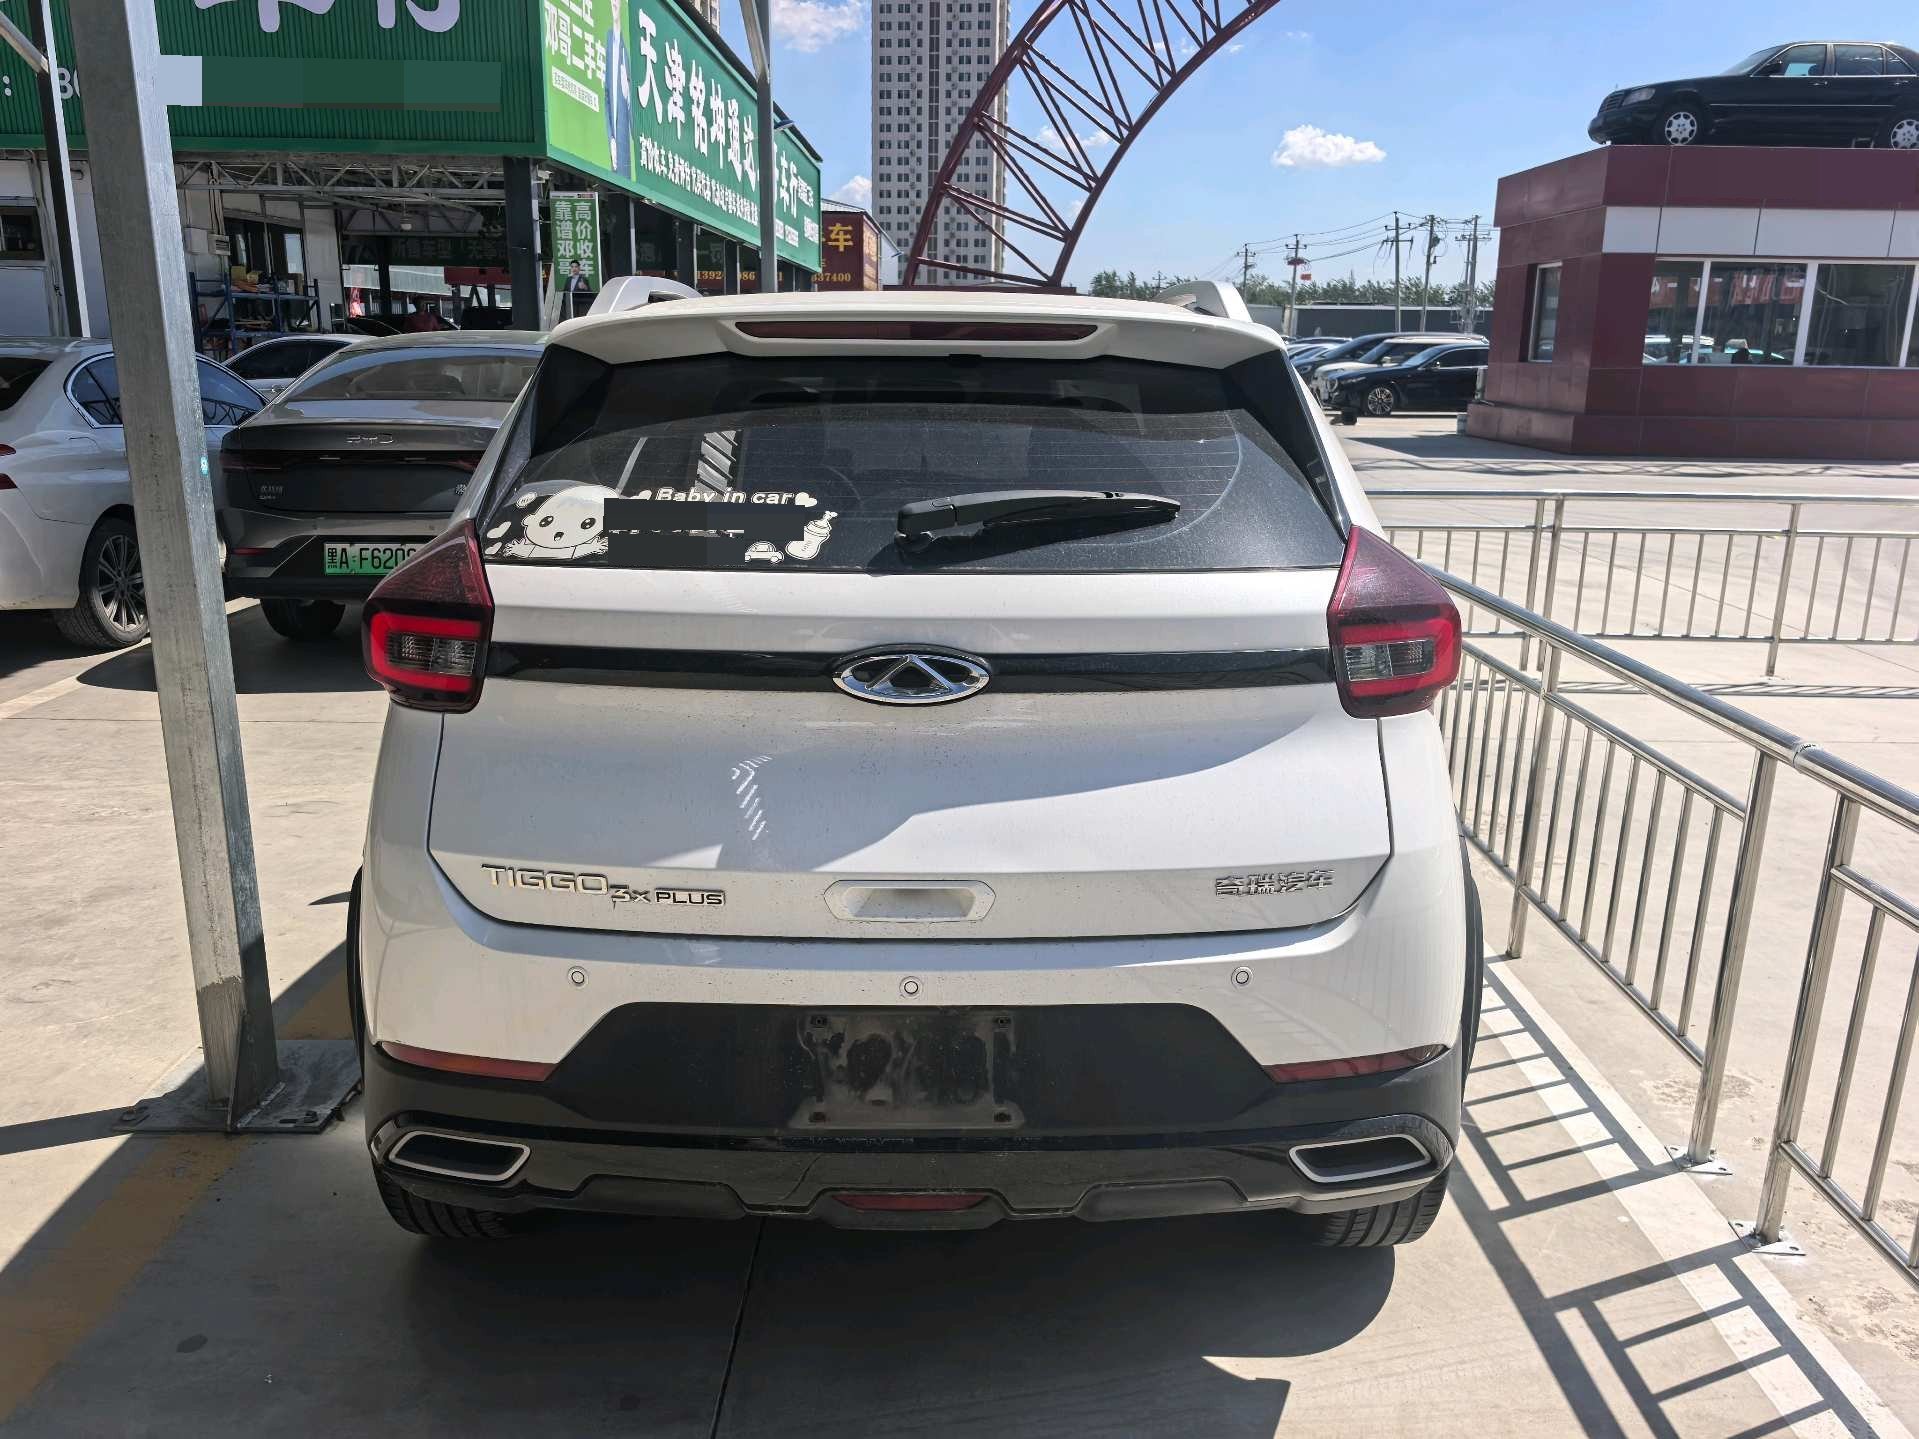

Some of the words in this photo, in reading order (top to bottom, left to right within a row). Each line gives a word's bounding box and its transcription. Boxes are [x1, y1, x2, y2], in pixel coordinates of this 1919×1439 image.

[554, 201, 575, 277] 靠谱邓哥
[573, 201, 595, 277] 高价收车
[821, 223, 853, 252] 车
[656, 487, 717, 503] Baby
[722, 487, 746, 504] in
[750, 491, 796, 506] car
[480, 863, 609, 897] TIGGO
[654, 887, 726, 907] PLUS
[1215, 869, 1335, 897] 奇瑞汽车
